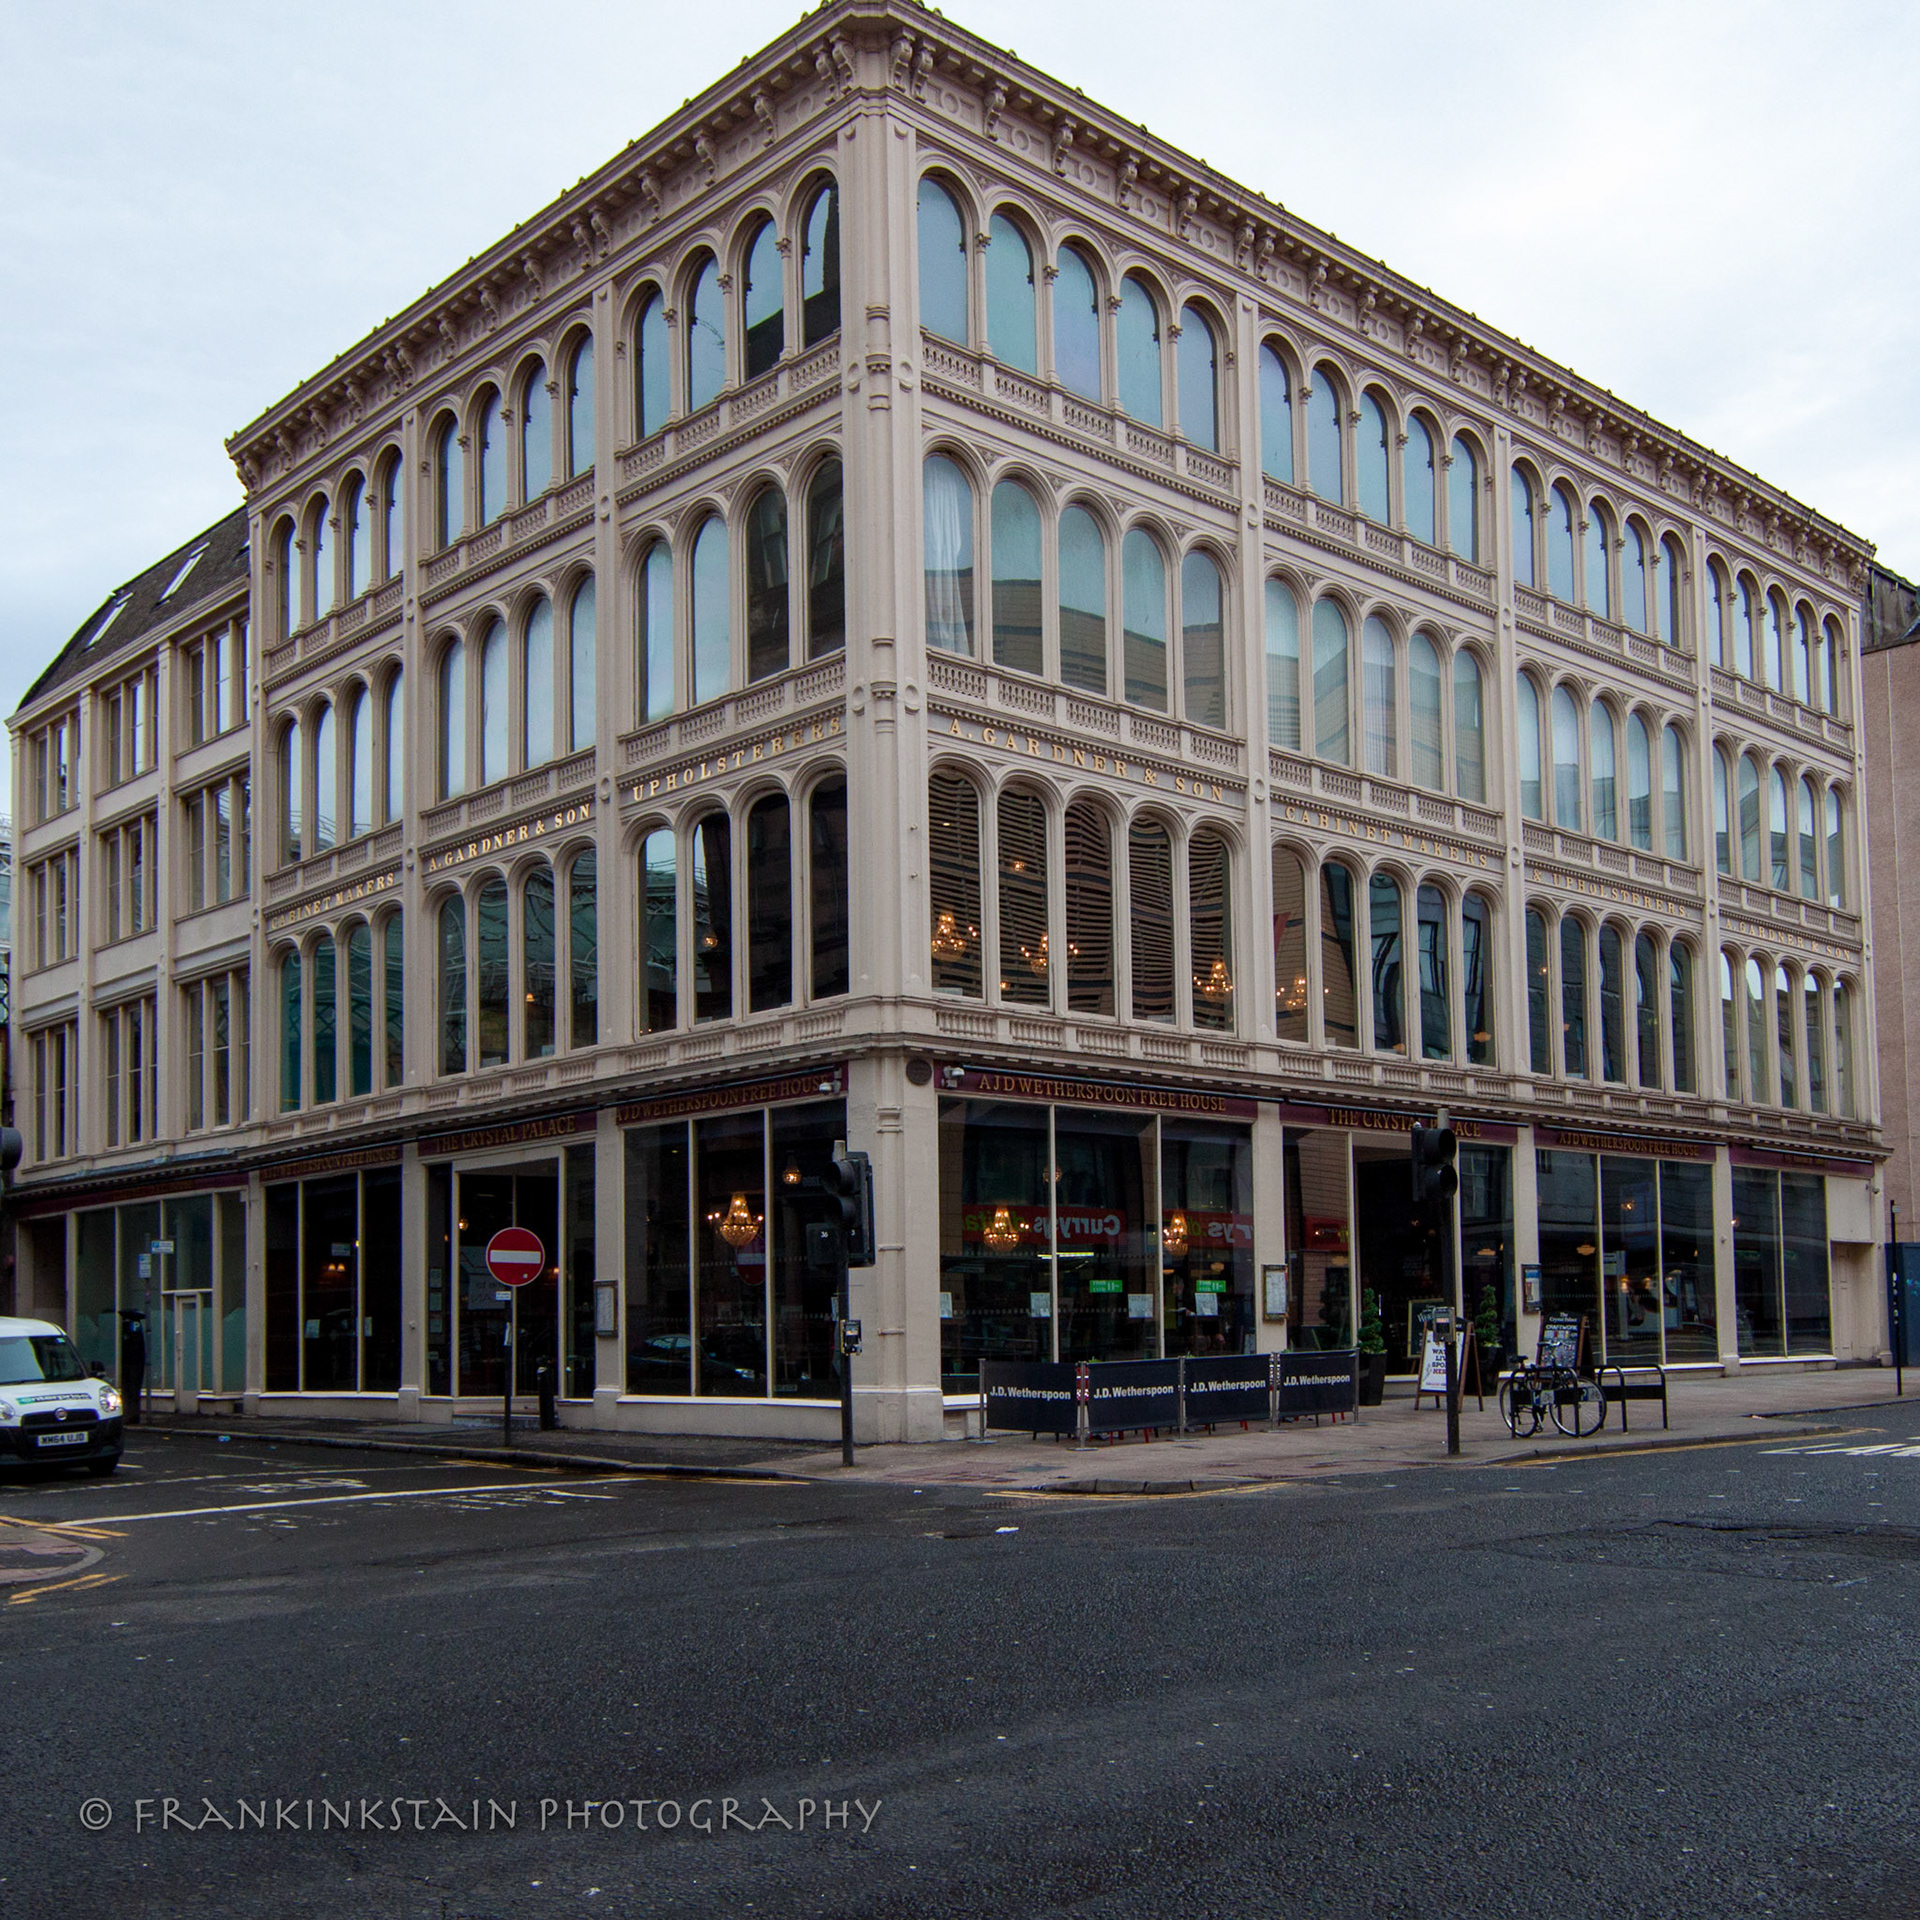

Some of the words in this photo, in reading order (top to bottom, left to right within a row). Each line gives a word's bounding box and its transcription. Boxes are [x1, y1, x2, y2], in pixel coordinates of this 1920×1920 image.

[633, 716, 841, 801] UPHOLSTERERS
[982, 727, 1129, 776] GARDNER
[1144, 767, 1158, 784] &
[1175, 776, 1223, 801] SON
[444, 824, 529, 865] GARDNER
[535, 820, 546, 835] &
[554, 803, 592, 828] SON
[1285, 806, 1391, 843] CABINET
[1402, 834, 1489, 868] MAKERS
[1532, 868, 1543, 882] &
[271, 896, 331, 930] CABINET
[334, 872, 396, 906] MAKERS
[1739, 921, 1804, 949] GARDNER
[1811, 940, 1820, 952] &
[1826, 943, 1852, 960] SON
[640, 1089, 739, 1119] WETHERSPOON
[741, 1084, 776, 1103] FREE
[1018, 1078, 1137, 1104] WETHERSPOON
[1140, 1089, 1176, 1108] FREE
[1179, 1093, 1226, 1112] HOUSE
[434, 1135, 458, 1152] THE
[463, 1126, 518, 1149] CRYSTAL
[522, 1114, 576, 1140] PALACE
[1328, 1107, 1359, 1127] THE
[1429, 1118, 1482, 1138] PACE
[1581, 1134, 1648, 1153] WETHERSPOON
[1649, 1140, 1671, 1155] FREE
[1672, 1143, 1699, 1157] HOUSE
